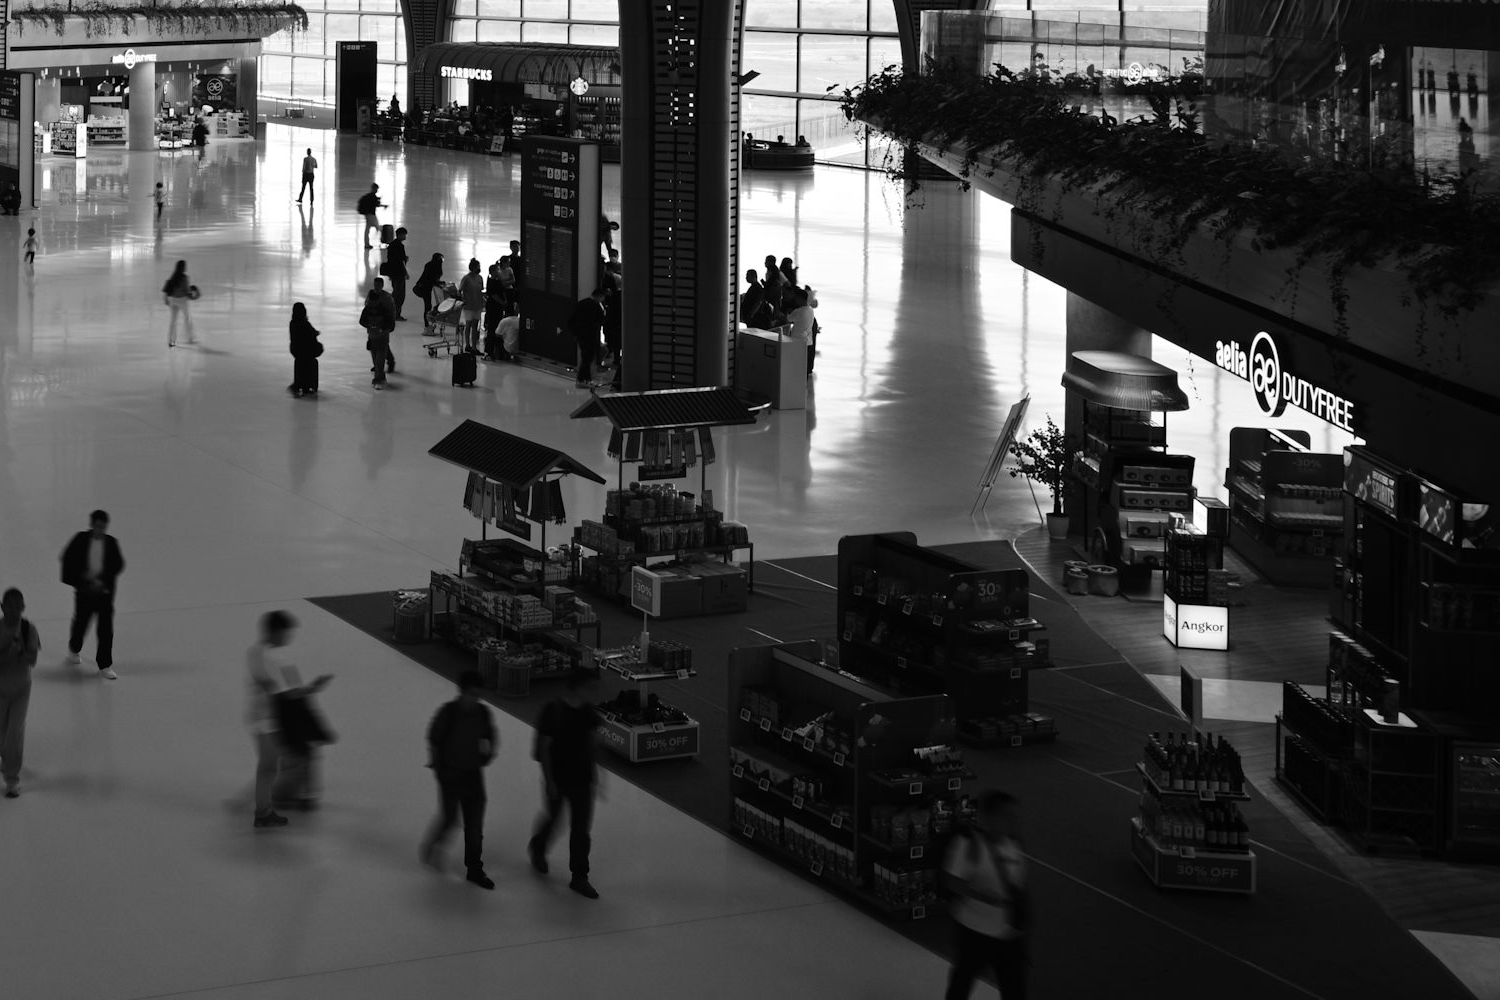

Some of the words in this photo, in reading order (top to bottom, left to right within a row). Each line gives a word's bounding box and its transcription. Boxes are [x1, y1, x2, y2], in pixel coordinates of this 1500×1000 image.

[440, 65, 493, 81] STARBUCKS
[1215, 339, 1248, 379] aelia
[1283, 371, 1355, 432] DUTYFREE
[1181, 620, 1225, 634] Angkor
[611, 732, 626, 745] OFF
[645, 738, 667, 750] 30%
[668, 736, 689, 747] OFF
[1176, 864, 1208, 876] 30%
[1210, 867, 1239, 879] OFF
